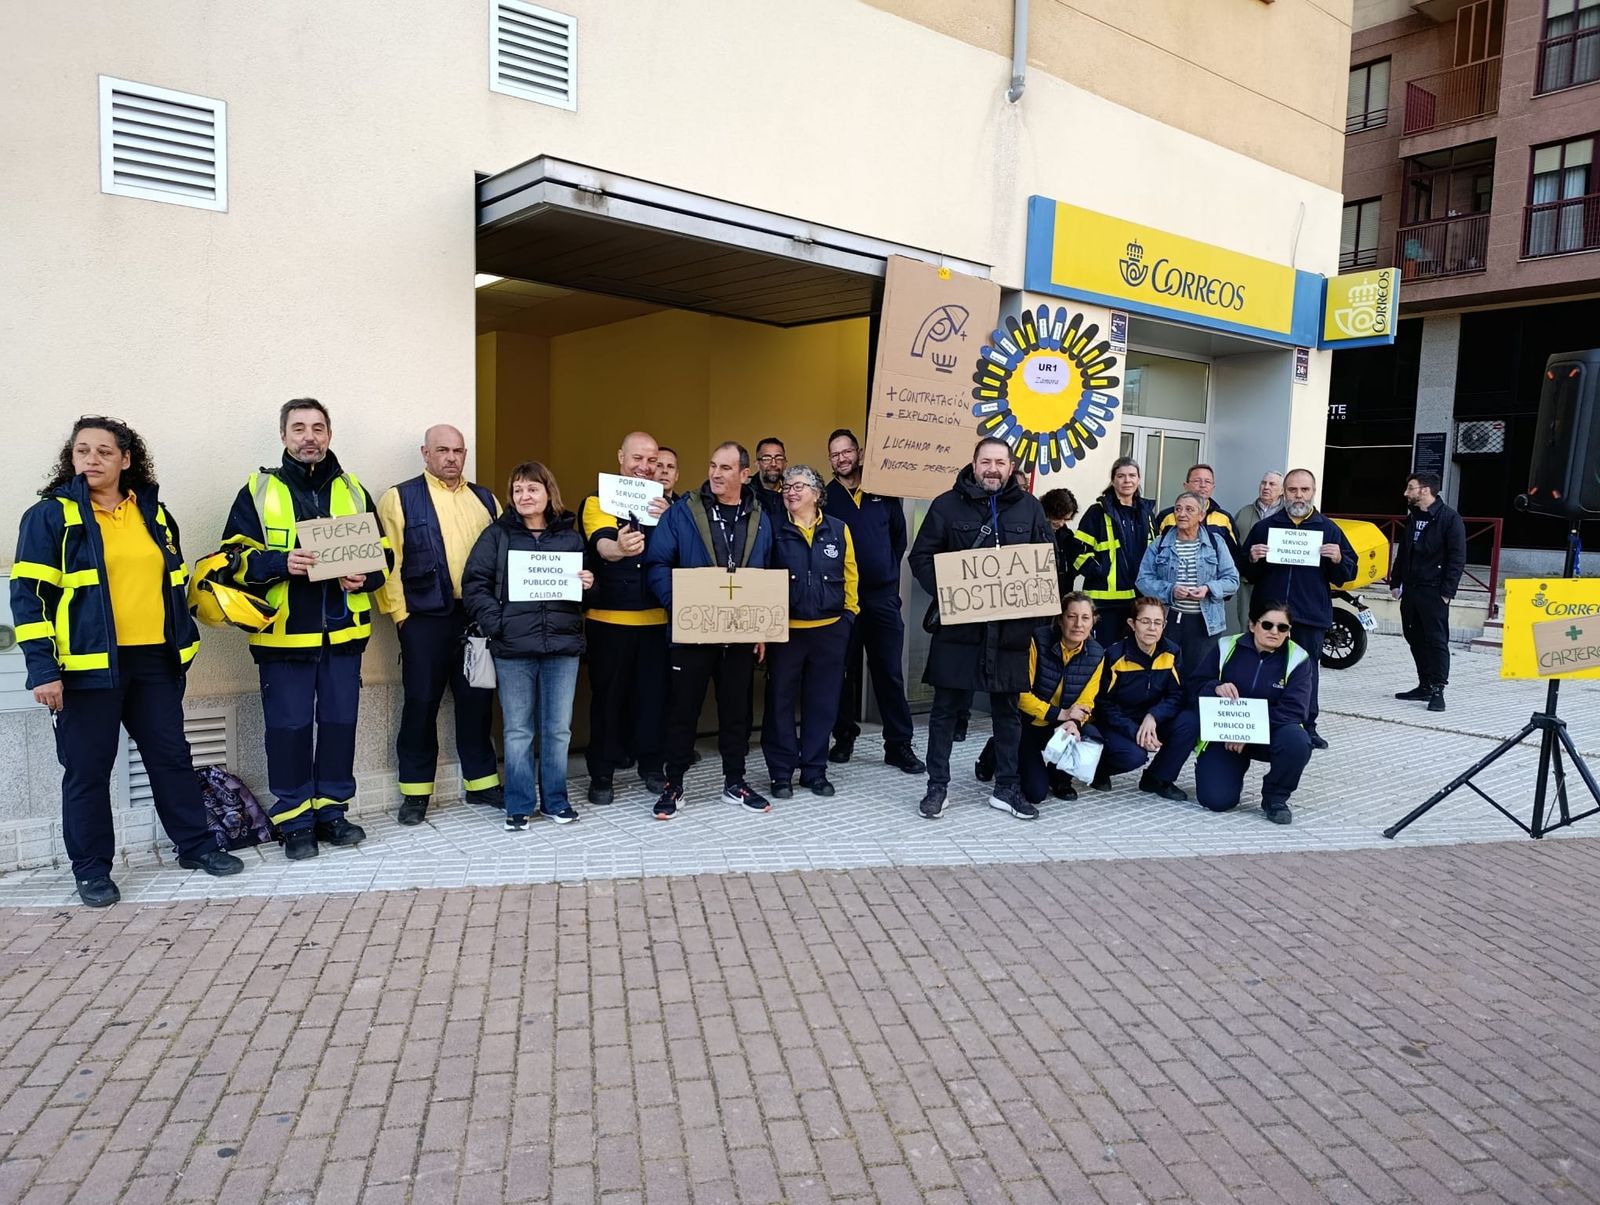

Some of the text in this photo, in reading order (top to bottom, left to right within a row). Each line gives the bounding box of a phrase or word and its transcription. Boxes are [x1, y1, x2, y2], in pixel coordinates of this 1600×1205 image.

[1151, 258, 1246, 311] CORREOS
[1372, 270, 1390, 333] CORREOS
[1038, 363, 1057, 372] UR1
[898, 409, 961, 426] EXPLOTACIÓN
[882, 436, 951, 454] LUCHANDO POR
[615, 489, 647, 500] SERVICIO
[312, 521, 371, 543] FUERA
[528, 566, 564, 574] SERVICIO
[961, 549, 1056, 580] NO A LA
